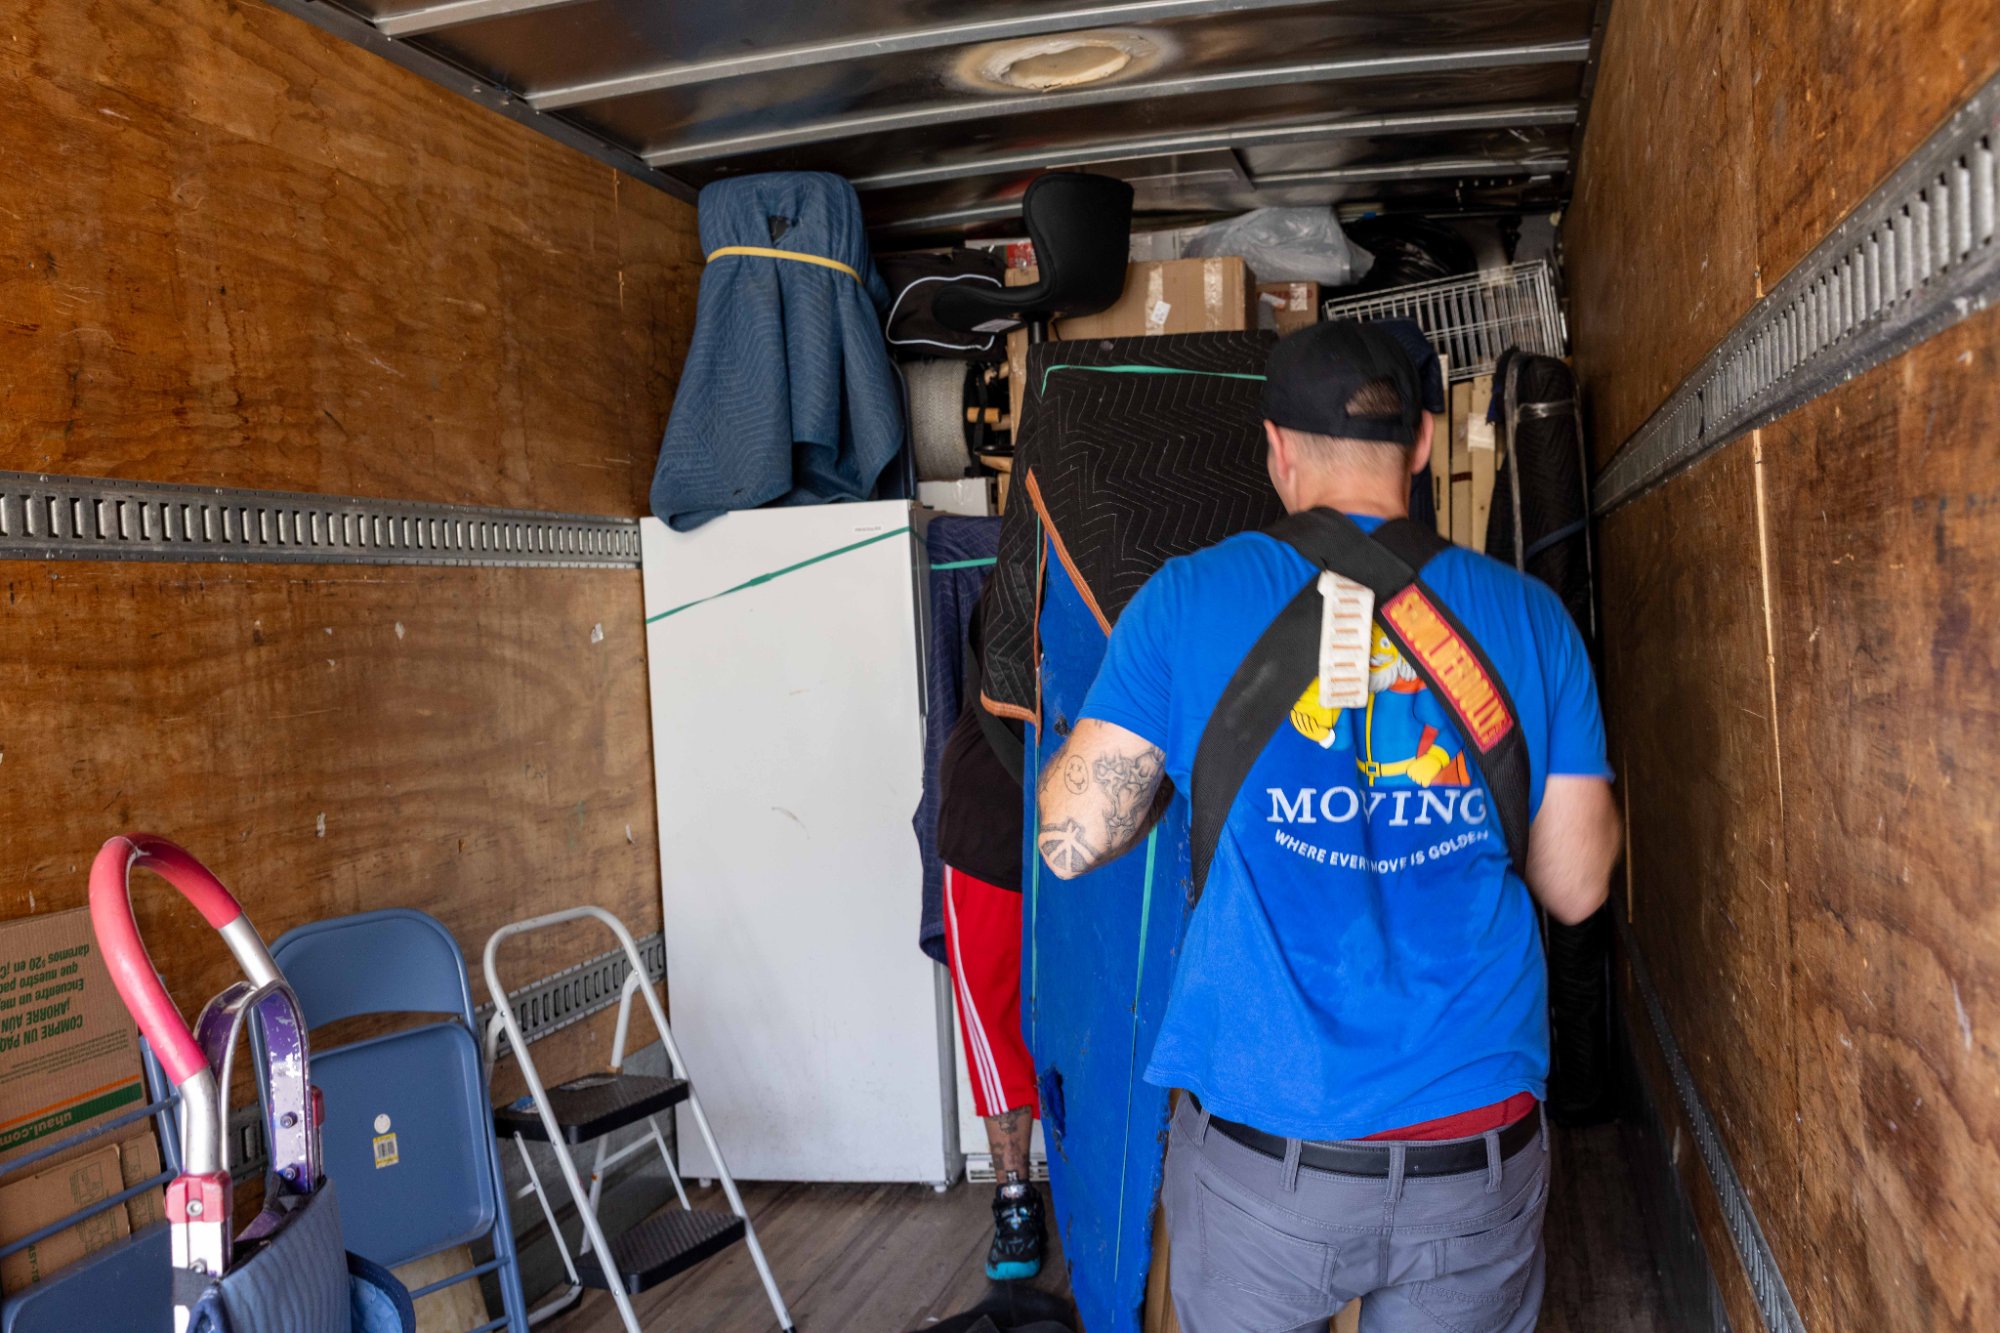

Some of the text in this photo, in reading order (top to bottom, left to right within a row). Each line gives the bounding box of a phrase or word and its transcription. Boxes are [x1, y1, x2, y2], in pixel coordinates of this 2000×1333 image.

[1266, 786, 1487, 827] MOVING
[1274, 829, 1327, 864] WHERE
[1410, 850, 1425, 867] IS
[1428, 829, 1488, 860] GOLDEN
[48, 944, 90, 963] daremos
[14, 961, 26, 973] en
[19, 969, 57, 989] nuestro
[60, 961, 78, 977] que
[0, 978, 84, 1011] Encuentre un me
[26, 997, 70, 1026] ¡AHORRE
[23, 1028, 38, 1045] UN
[41, 1014, 83, 1039] COMPRE
[0, 1112, 73, 1145] uhaul.com
